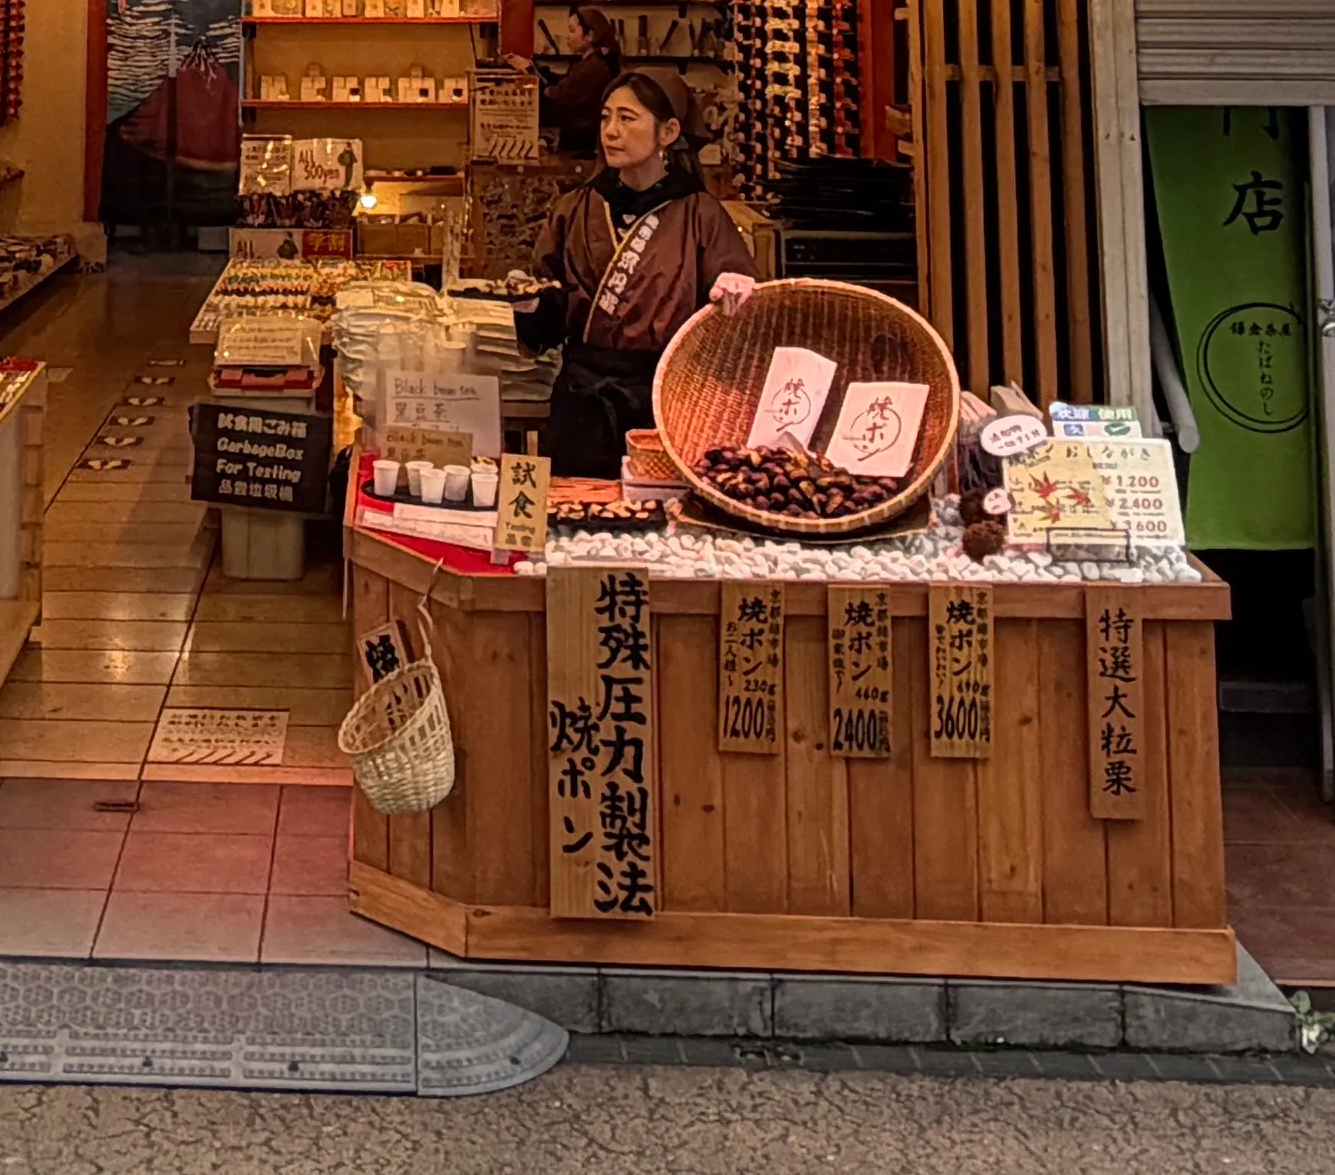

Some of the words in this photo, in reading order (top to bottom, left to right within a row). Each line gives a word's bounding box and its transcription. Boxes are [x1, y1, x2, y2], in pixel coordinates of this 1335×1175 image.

[216, 458, 244, 475] For
[509, 462, 536, 518] 試食
[722, 693, 766, 741] 1200
[933, 693, 980, 741] 3600
[1099, 608, 1137, 796] 特選大粒栗
[593, 572, 655, 919] 特殊圧力製法
[832, 706, 878, 753] 2400
[549, 697, 599, 854] 焼ポン
